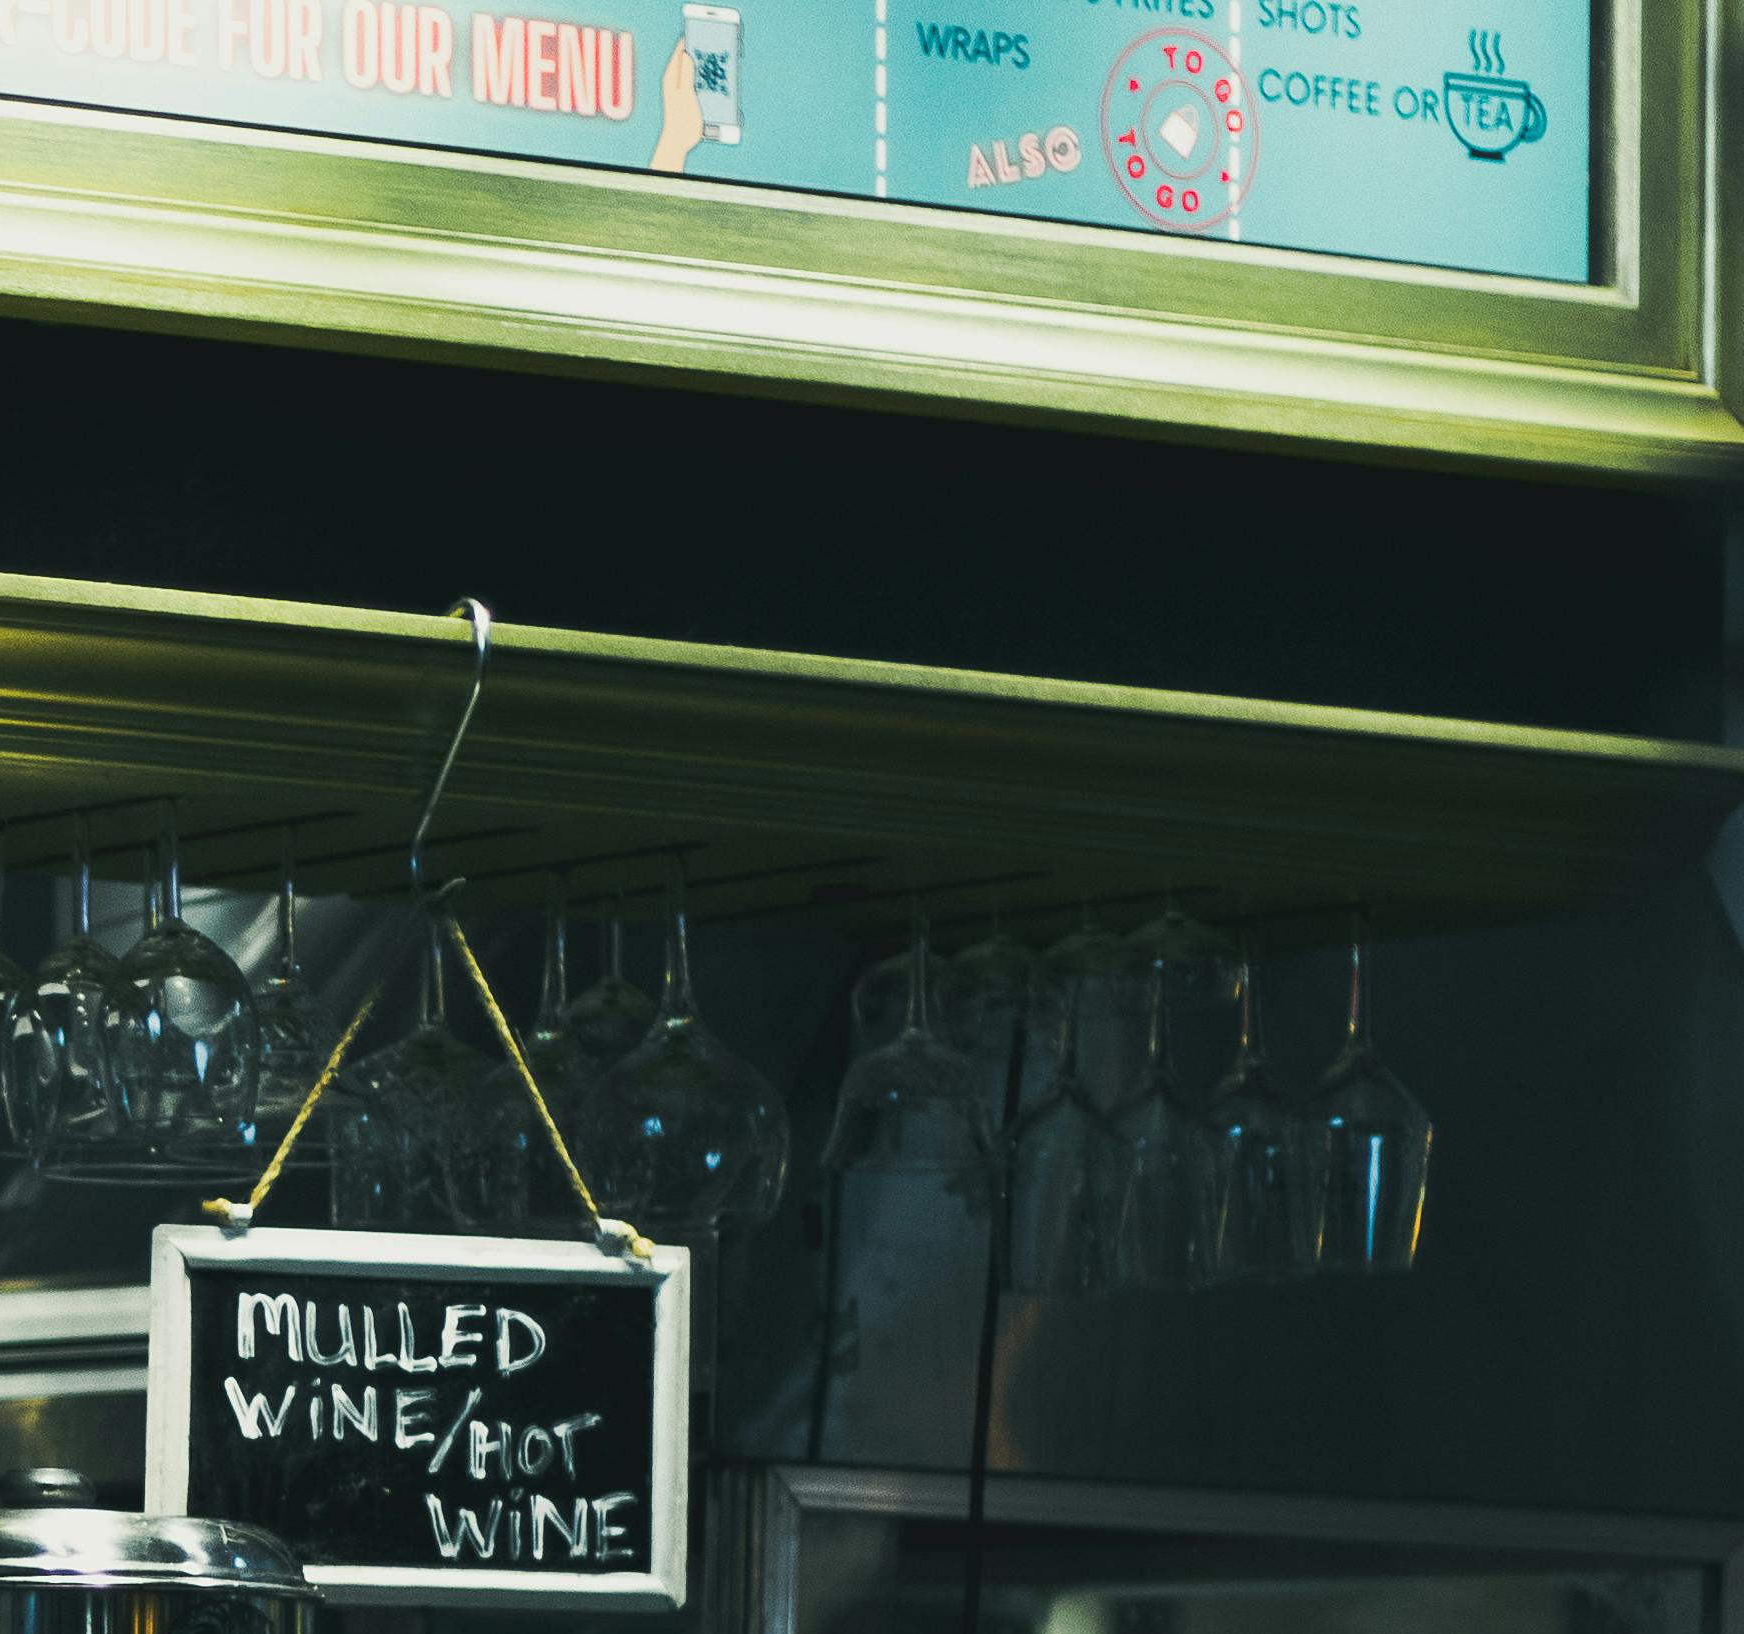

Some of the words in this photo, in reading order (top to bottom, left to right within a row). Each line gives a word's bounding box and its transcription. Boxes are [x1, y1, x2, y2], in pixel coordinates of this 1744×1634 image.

[915, 20, 1031, 69] WRAPS
[1257, 0, 1362, 39] SHOTS
[219, 0, 322, 82] FOR
[343, 2, 453, 98] OUR
[472, 12, 634, 121] MENU
[1162, 45, 1204, 75] TO
[1258, 68, 1381, 117] COFFEE
[1393, 85, 1441, 124] OR
[1461, 91, 1513, 132] TEA
[968, 126, 1082, 189] ALSO
[236, 1290, 548, 1376] MULLED
